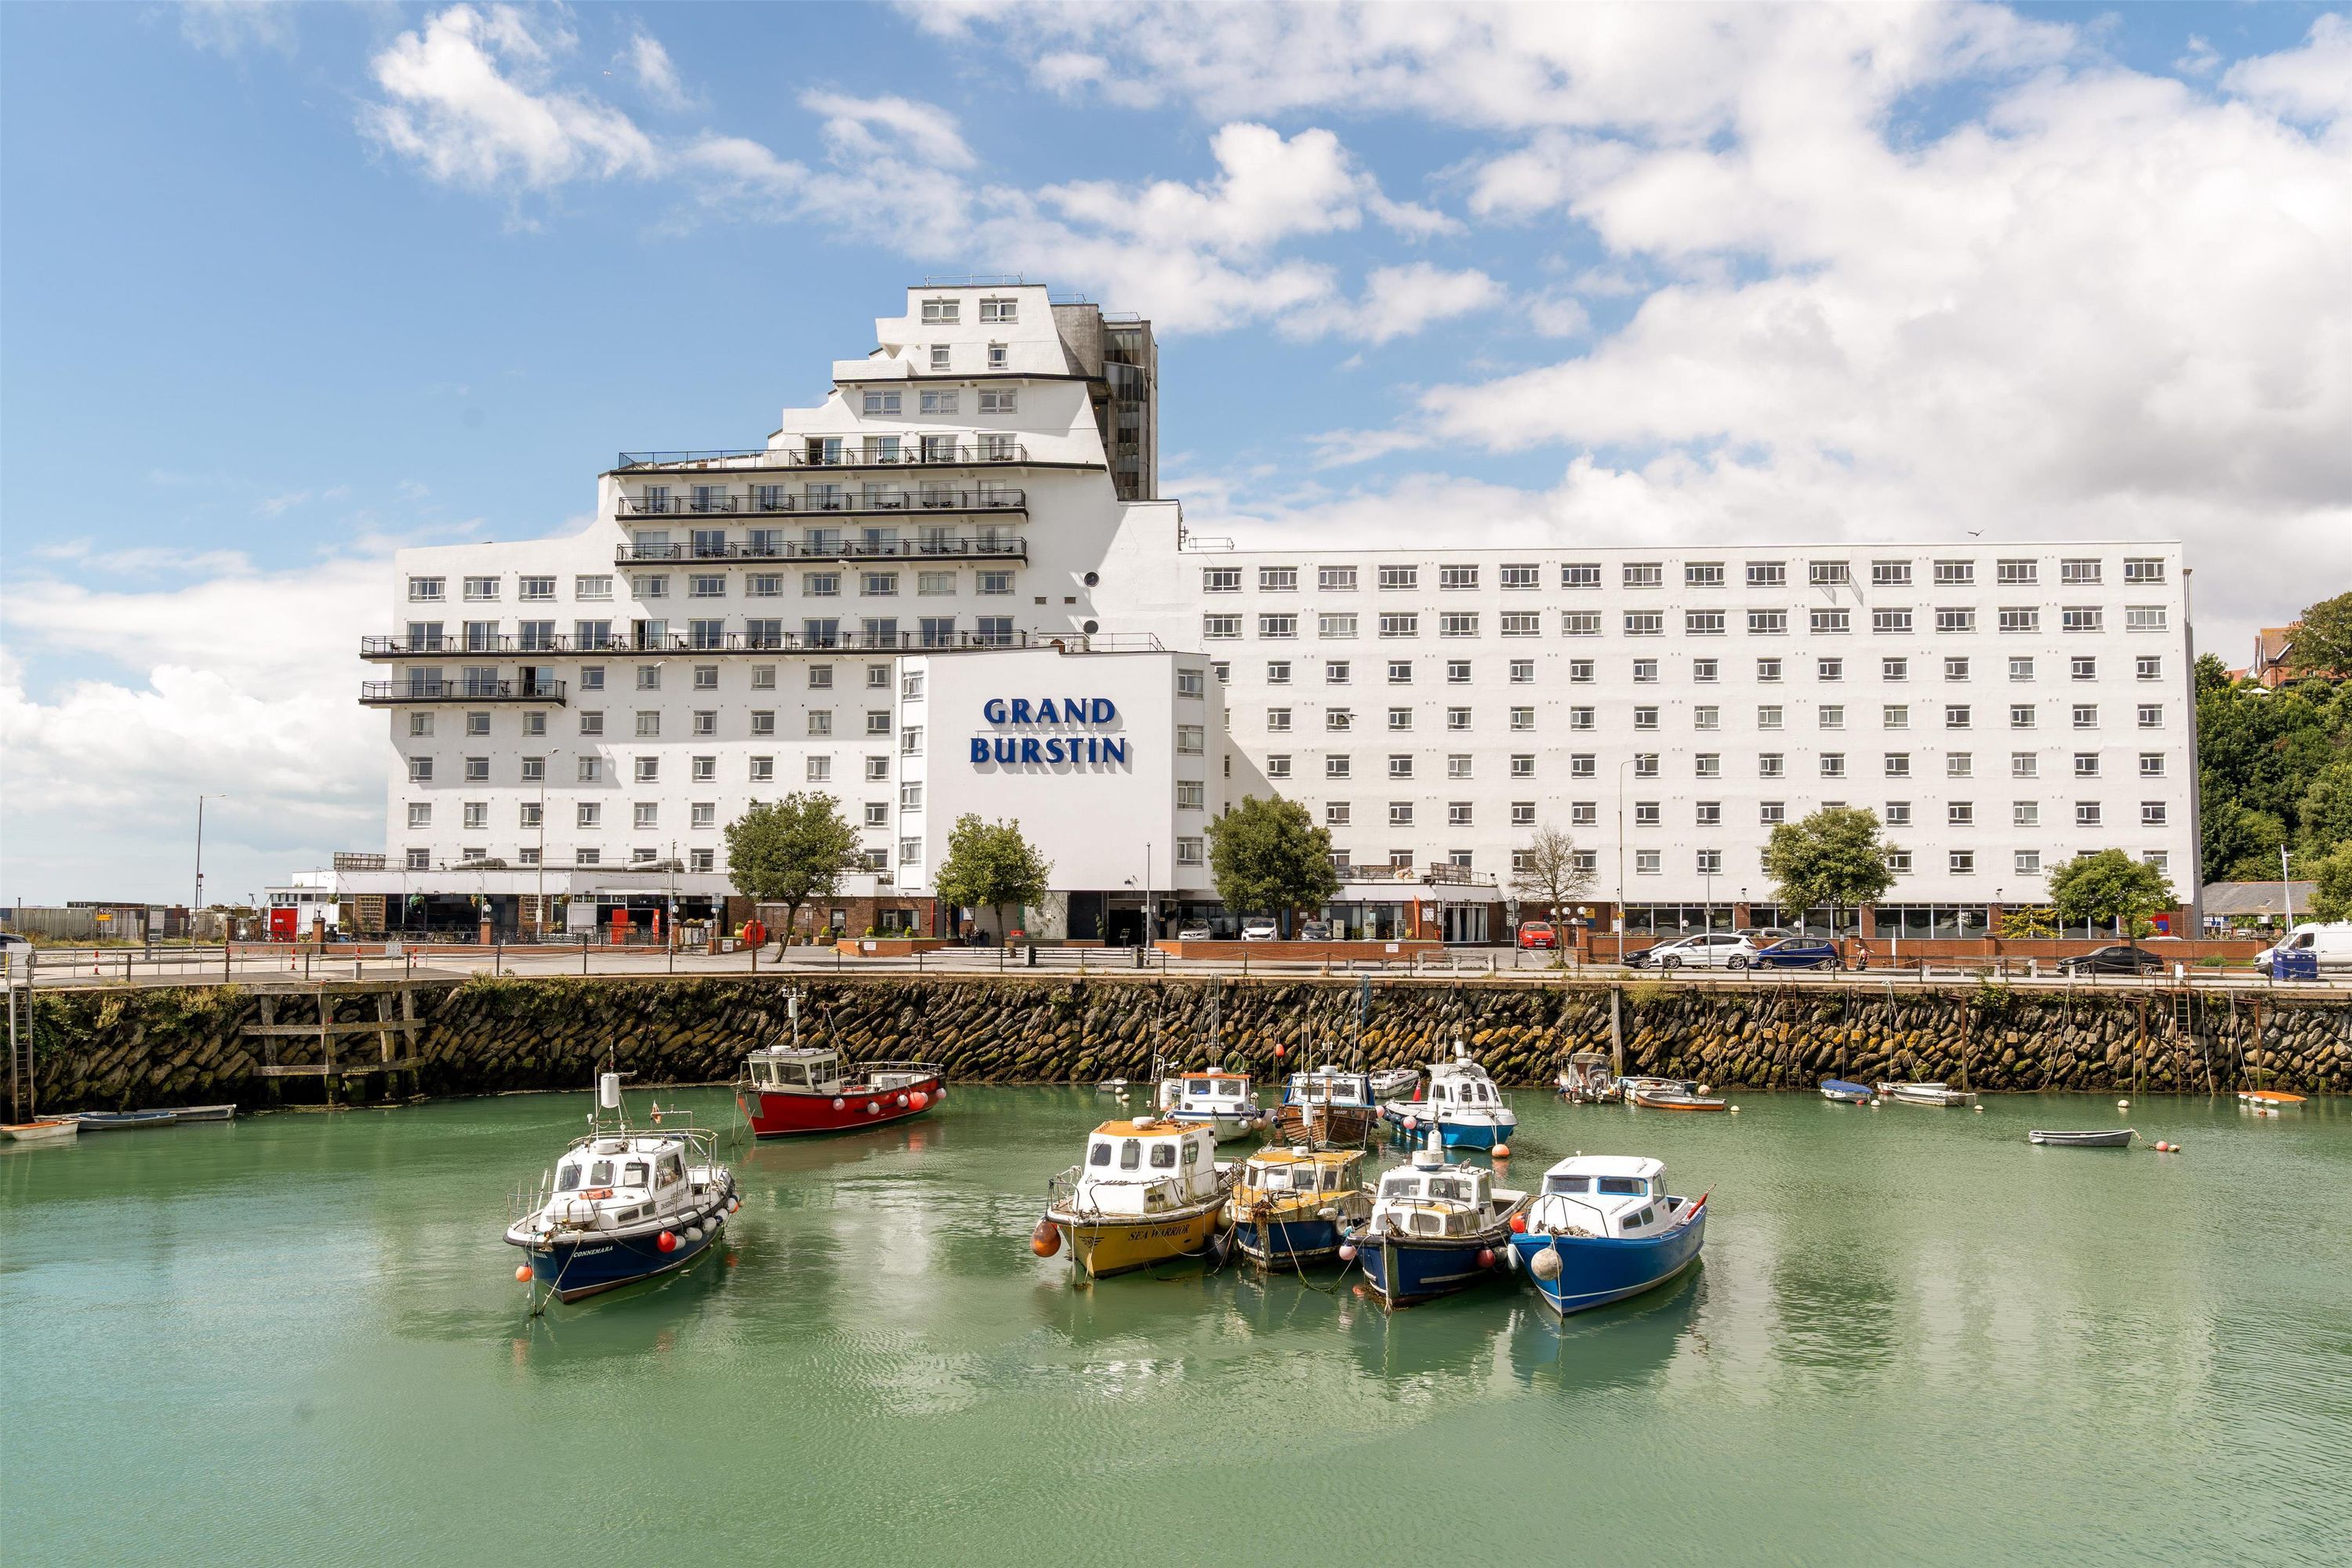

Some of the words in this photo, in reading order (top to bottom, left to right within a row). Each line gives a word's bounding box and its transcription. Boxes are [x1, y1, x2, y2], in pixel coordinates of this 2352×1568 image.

[983, 698, 1116, 724] GRAND
[970, 737, 1126, 764] BURSTIN
[1127, 1230, 1149, 1241] SEA
[1151, 1224, 1190, 1238] WARRIOR
[573, 1245, 613, 1258] CONNEMARA
